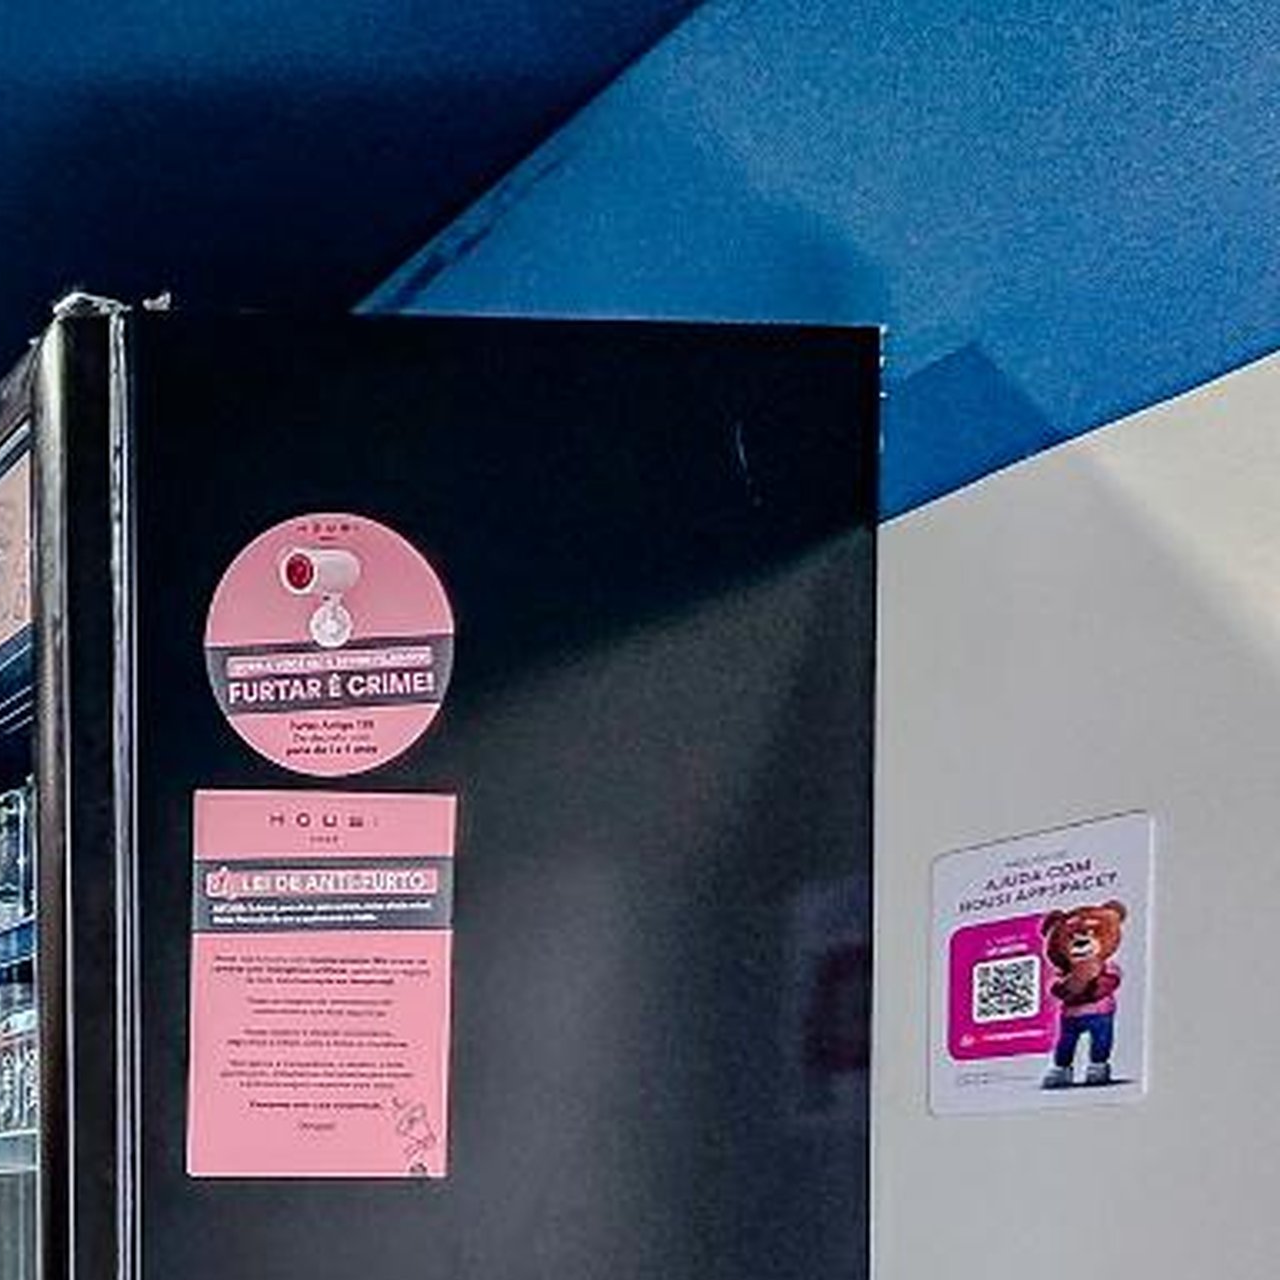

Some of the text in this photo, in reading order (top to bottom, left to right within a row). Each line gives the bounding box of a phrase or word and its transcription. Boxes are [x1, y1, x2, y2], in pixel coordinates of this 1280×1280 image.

[228, 678, 322, 704] FURTAR
[347, 672, 435, 697] CRIME!
[985, 870, 1041, 891] AJUDA
[1045, 857, 1092, 878] COM
